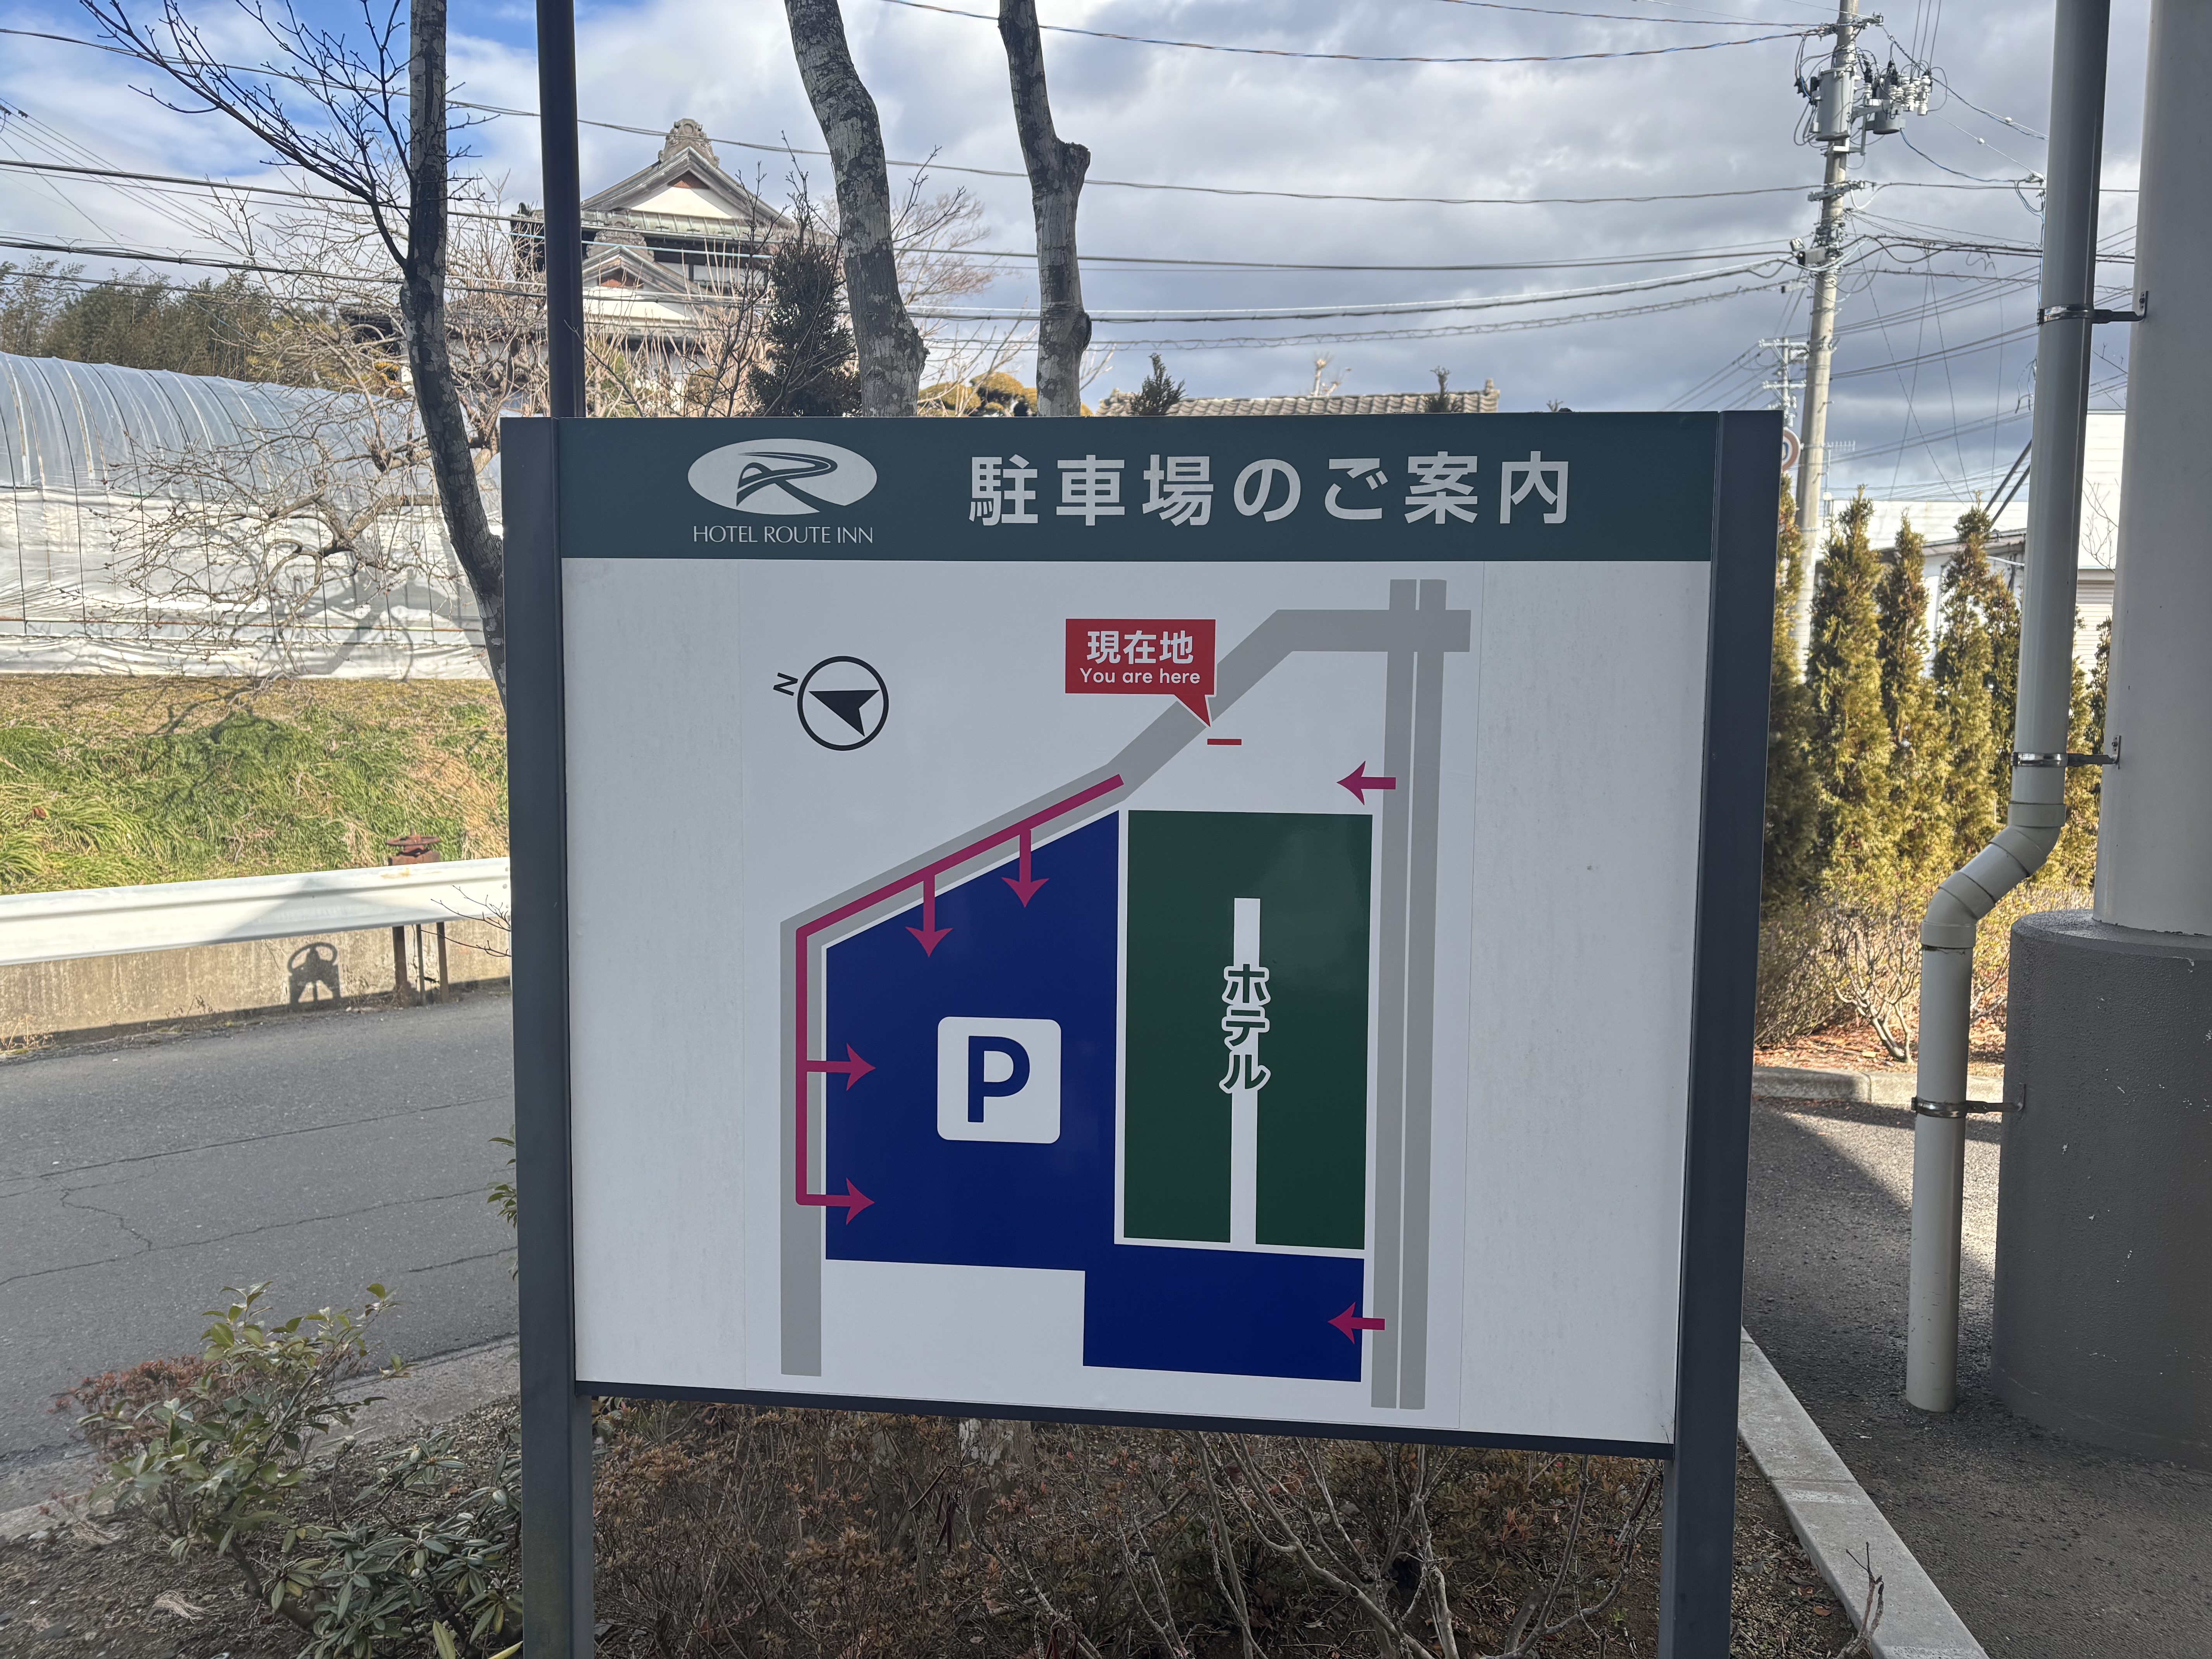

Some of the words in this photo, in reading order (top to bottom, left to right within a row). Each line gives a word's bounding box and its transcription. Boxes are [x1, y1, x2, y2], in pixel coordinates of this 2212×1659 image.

[969, 451, 1568, 526] 駐車場のご案内
[694, 526, 758, 542] HOTEL
[764, 526, 831, 543] ROUTE
[838, 527, 872, 543] INN
[1087, 630, 1194, 665] 現在地
[773, 672, 799, 696] N
[1080, 668, 1115, 683] You
[1122, 672, 1152, 684] are
[1160, 668, 1200, 684] here
[1222, 963, 1268, 1091] ホテル
[967, 1036, 1030, 1123] P
